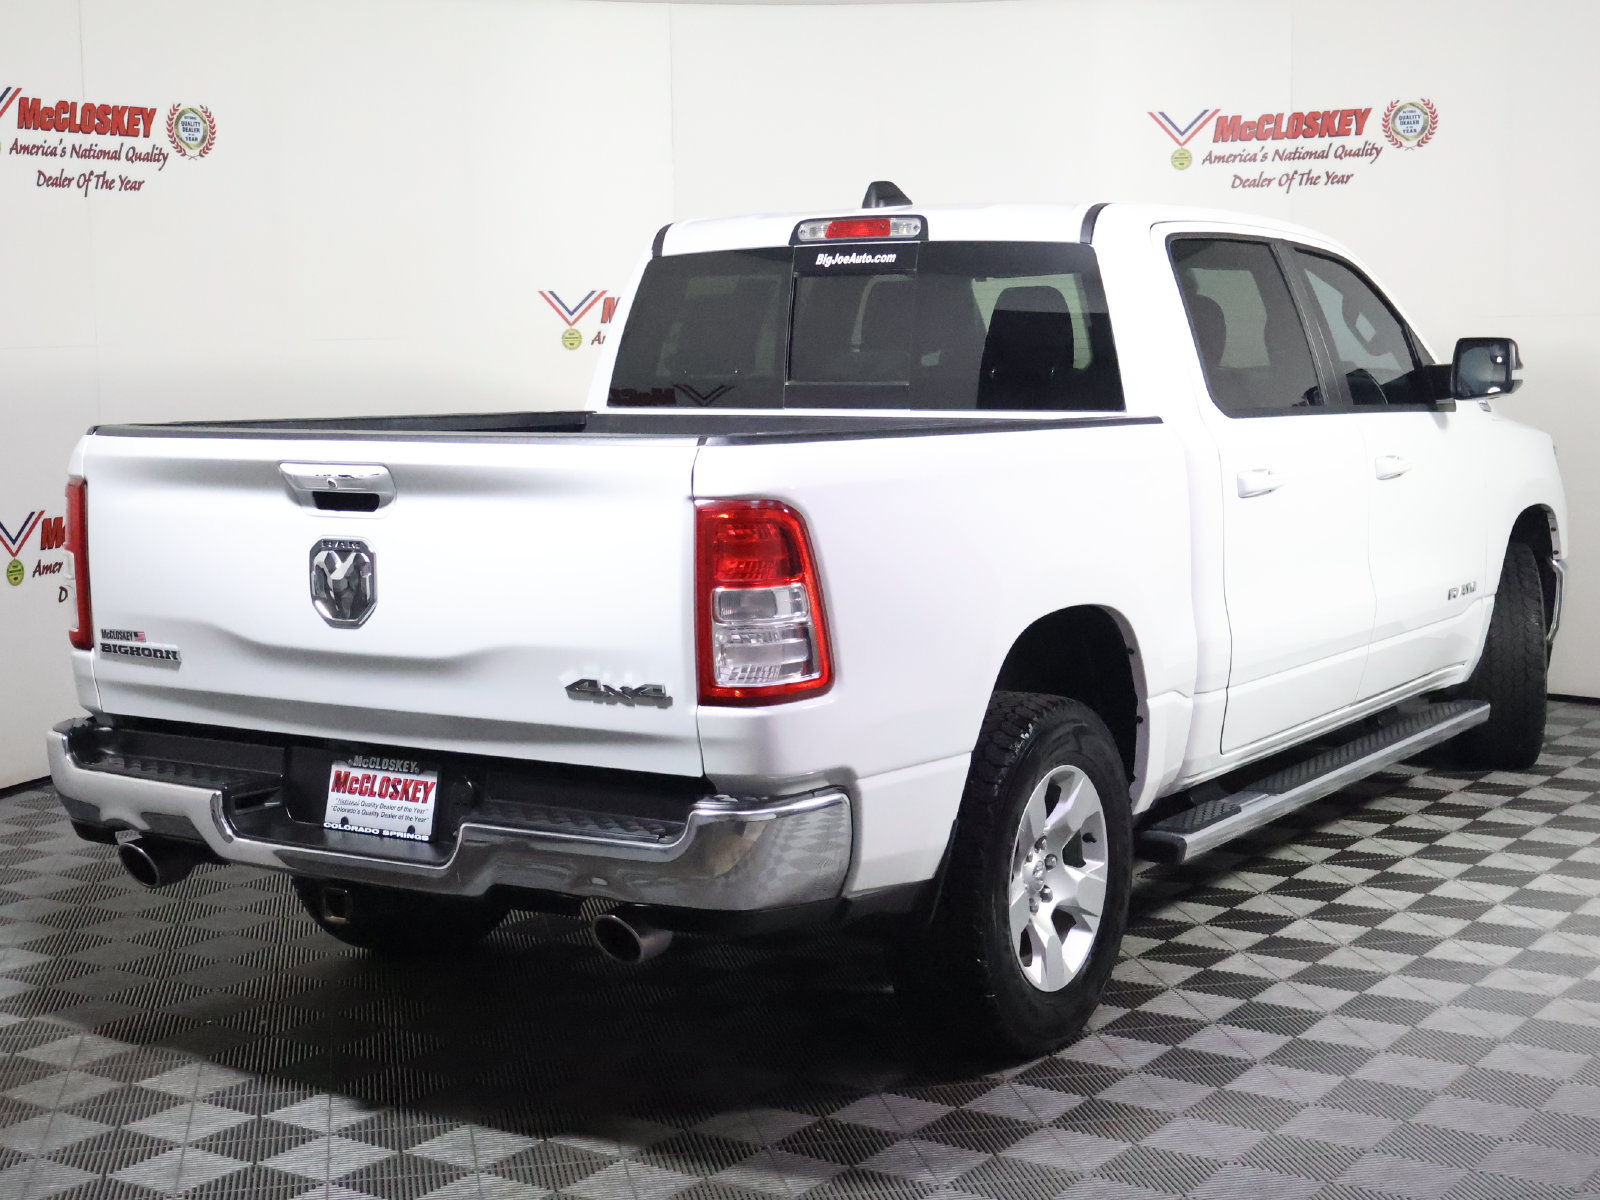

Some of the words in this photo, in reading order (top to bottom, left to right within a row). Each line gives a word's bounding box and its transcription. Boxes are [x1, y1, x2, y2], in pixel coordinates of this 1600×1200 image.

[17, 96, 157, 138] McCLOSKEY
[1212, 107, 1372, 143] McCLOSKEY
[9, 138, 67, 158] America's
[70, 142, 122, 161] National
[125, 146, 169, 171] Quality
[1202, 146, 1268, 165] America's
[1272, 143, 1329, 163] National
[1334, 140, 1383, 164] Quality
[36, 168, 74, 188] Dealer
[76, 170, 94, 198] Of
[94, 171, 116, 191] The
[118, 175, 145, 192] Year
[1231, 171, 1276, 189] Dealer
[1278, 170, 1299, 194] Of
[1297, 170, 1320, 187] The
[1324, 172, 1354, 186] Year
[815, 252, 897, 267] BigJoeAuto.com
[100, 643, 178, 660] BIGHORN
[331, 770, 437, 804] McCLOSKEY
[360, 800, 379, 809] Quality
[379, 803, 396, 811] Dealer
[404, 805, 413, 813] the
[361, 809, 380, 818] Quality
[380, 811, 398, 819] Dealer
[323, 822, 380, 835] COLORADO
[382, 831, 430, 841] SPRINGS
